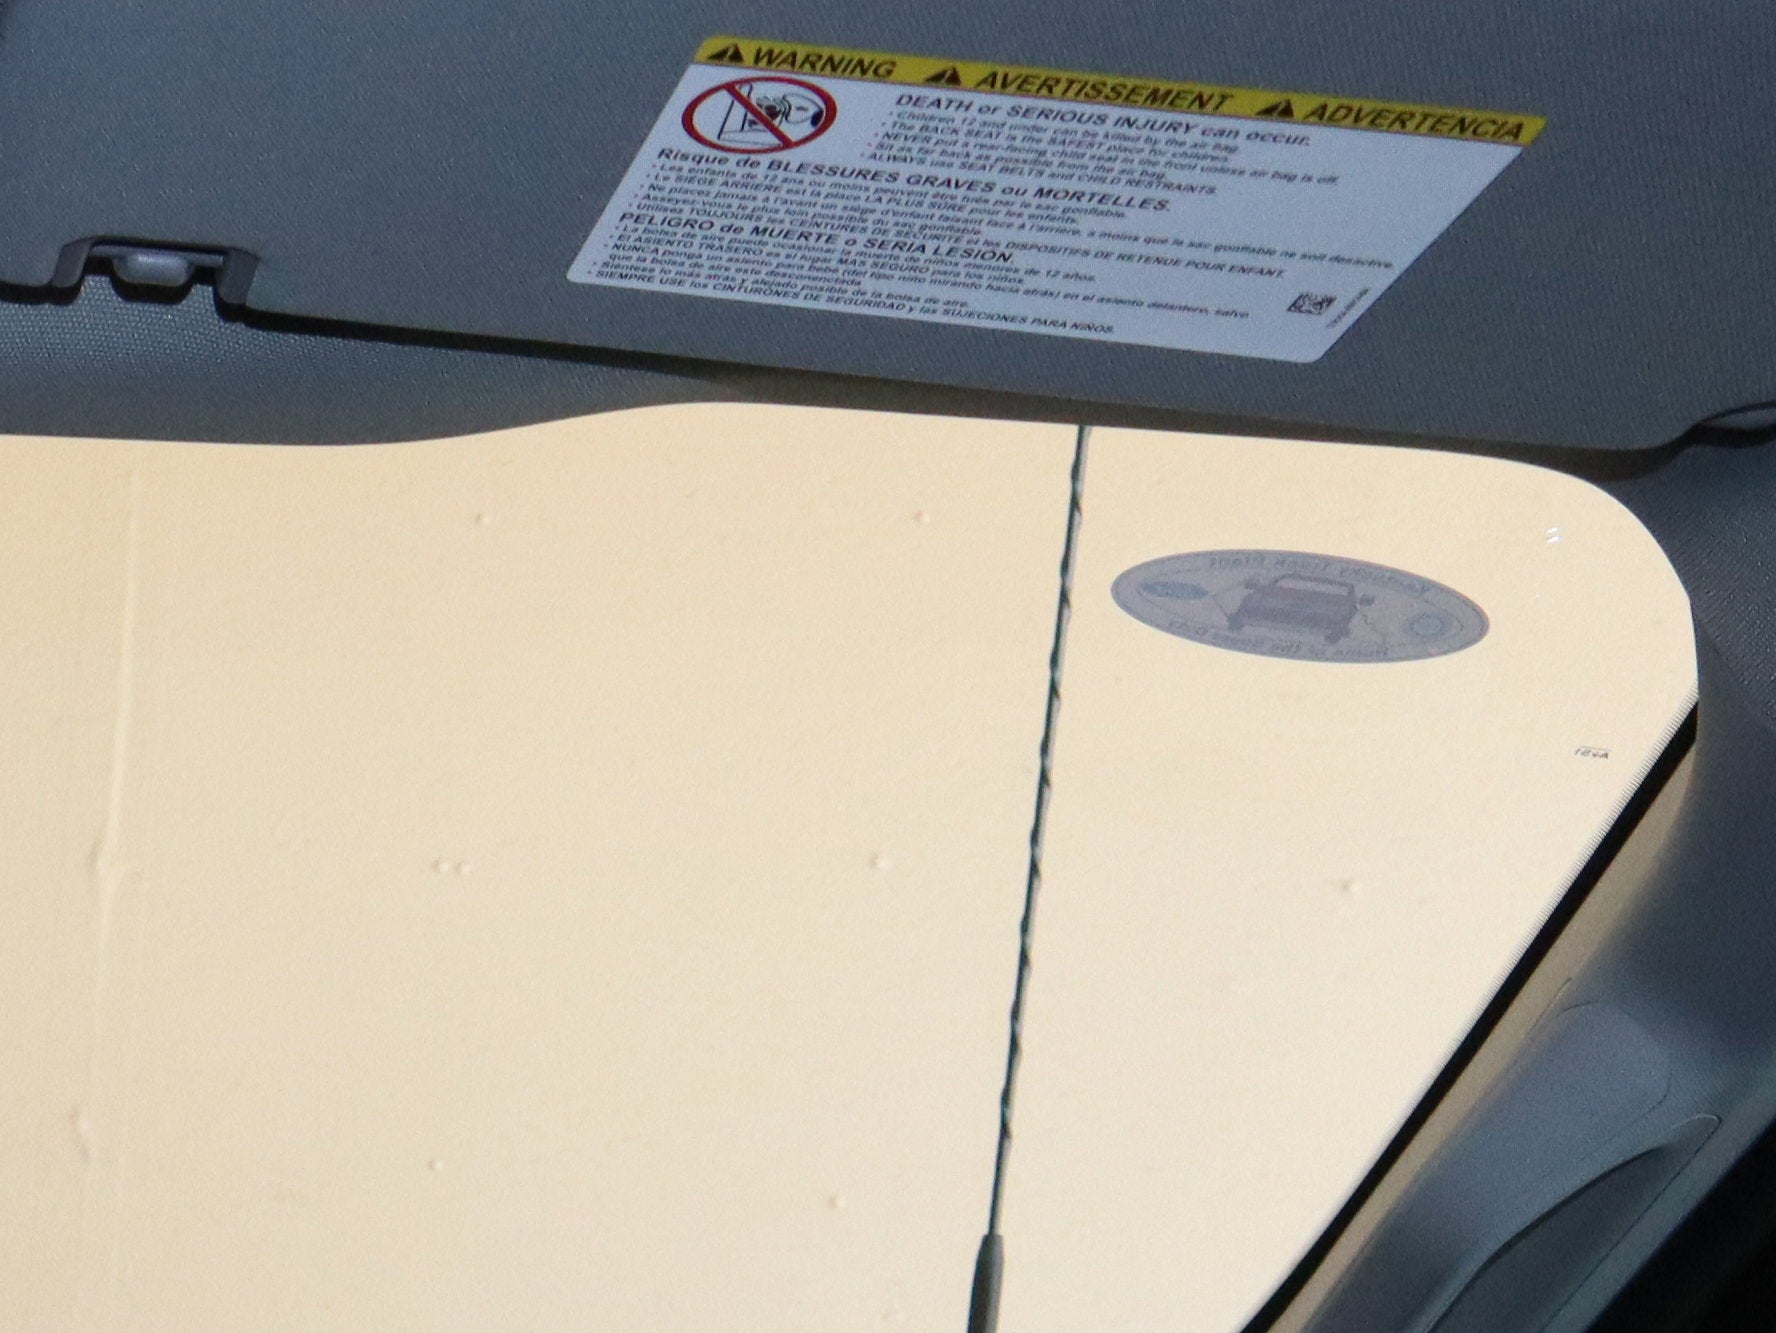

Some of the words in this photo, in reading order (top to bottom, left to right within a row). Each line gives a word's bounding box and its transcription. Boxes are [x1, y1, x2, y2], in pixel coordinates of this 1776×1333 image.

[749, 48, 898, 78] WARNING
[974, 70, 1234, 110] AVERTISSEMENT
[1302, 103, 1531, 139] ADVERTENCIA
[896, 95, 973, 110] DEATH
[976, 102, 1002, 114] or
[1006, 106, 1109, 124] SERIOUS
[1113, 116, 1196, 132] INJURY
[1201, 125, 1241, 137] can
[1246, 130, 1314, 144] occur.
[657, 149, 729, 167] Risque
[734, 156, 764, 168] de
[768, 161, 900, 181] BLESSURES
[906, 175, 996, 191] GRAVES
[999, 186, 1029, 195] ou
[1033, 188, 1175, 210] MORTELLES.
[620, 213, 714, 229] PELIGRO
[718, 223, 746, 233] de
[751, 227, 839, 242] MUERTE
[843, 236, 860, 245] o
[864, 239, 928, 251] SERIA
[934, 244, 1019, 261] LESIÓN.
